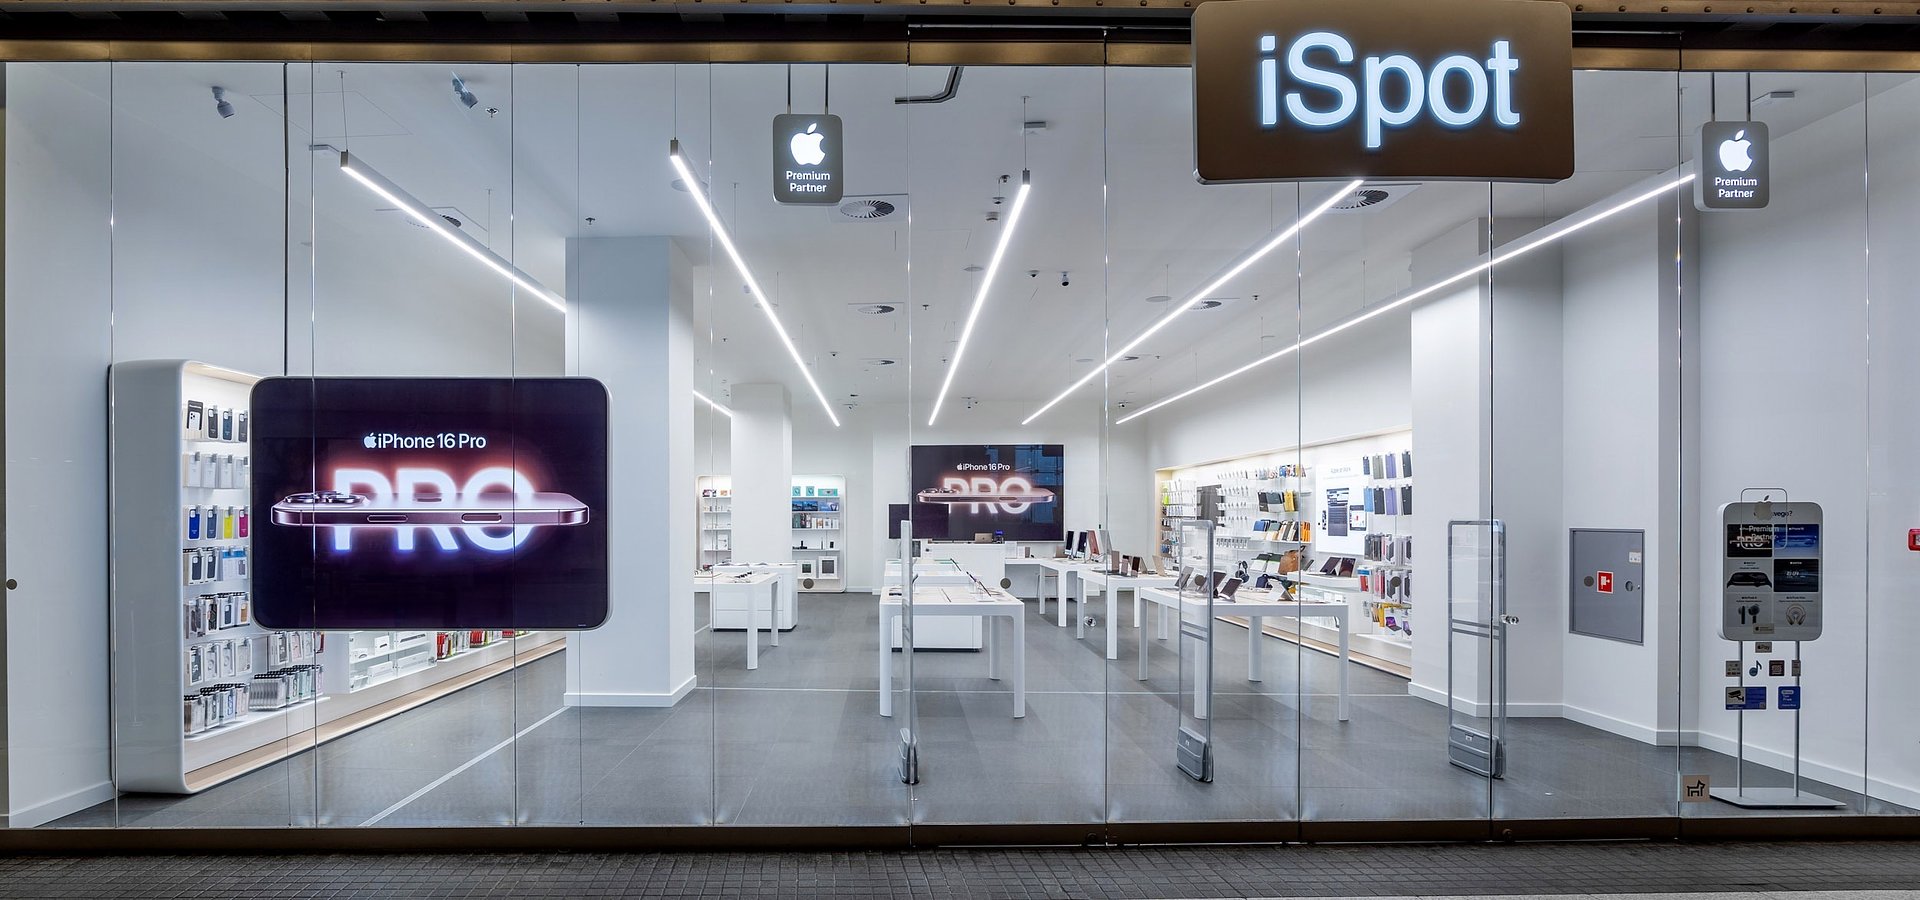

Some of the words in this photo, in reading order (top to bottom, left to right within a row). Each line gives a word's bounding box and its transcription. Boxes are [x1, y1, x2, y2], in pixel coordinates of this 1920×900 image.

[1260, 32, 1520, 148] iSpot
[786, 170, 830, 180] Premium
[1715, 177, 1757, 186] Premium
[789, 182, 827, 192] Partner
[1718, 189, 1754, 198] Partner
[378, 432, 435, 449] iPhone
[437, 433, 456, 449] 16
[459, 433, 487, 449] Pro
[963, 463, 988, 471] iPhone
[988, 463, 997, 471] 16
[944, 477, 1032, 514] PRO
[334, 467, 535, 551] PRO
